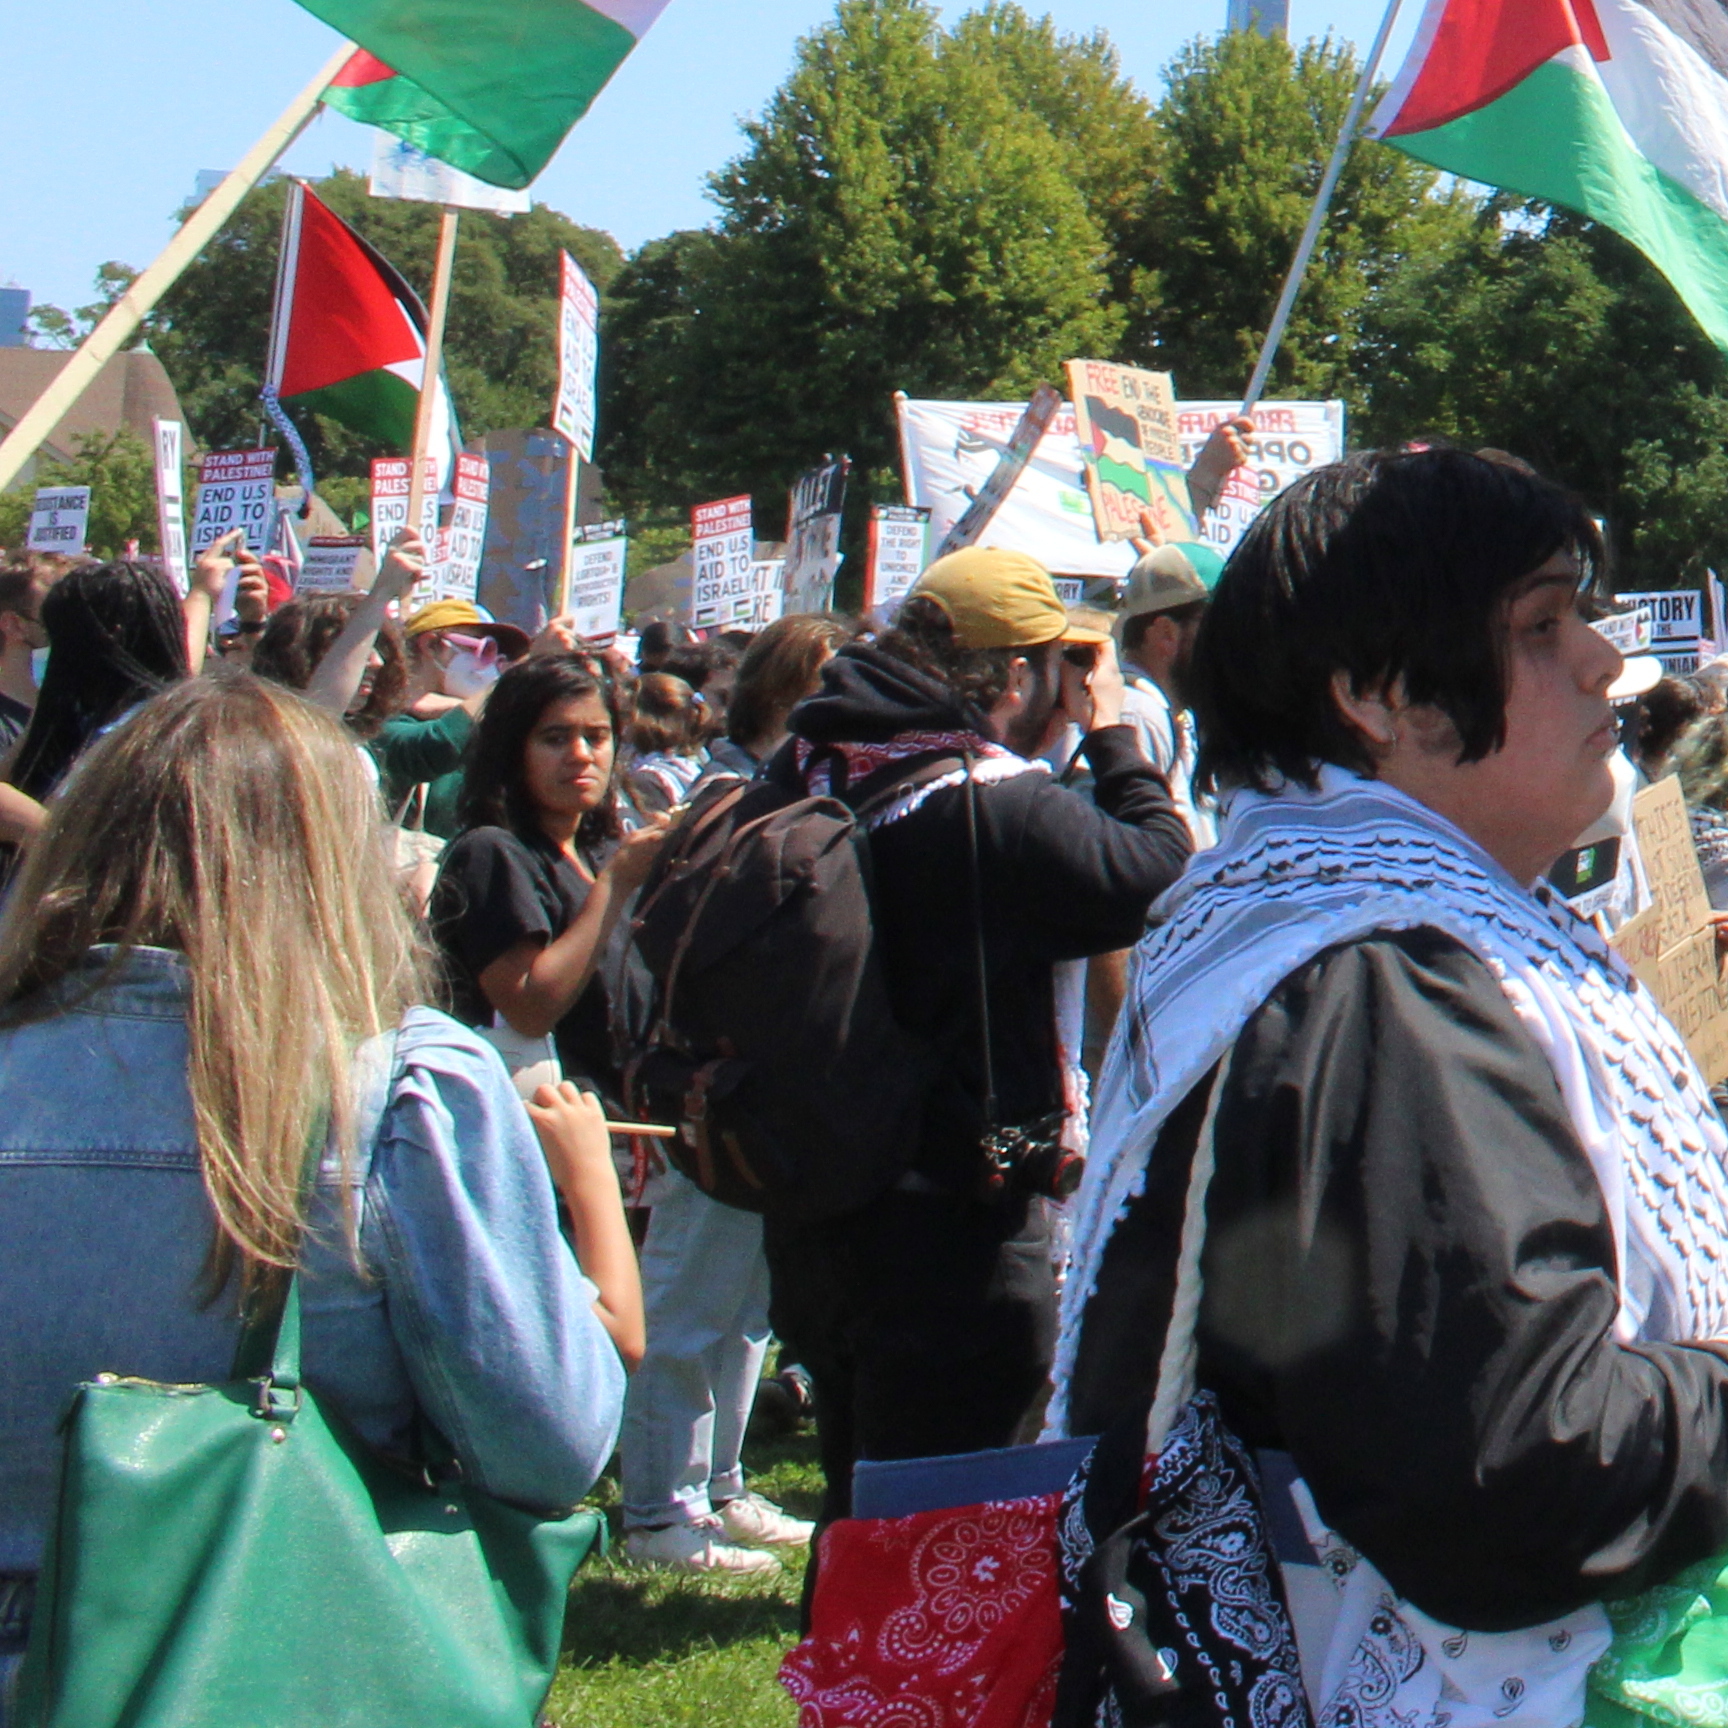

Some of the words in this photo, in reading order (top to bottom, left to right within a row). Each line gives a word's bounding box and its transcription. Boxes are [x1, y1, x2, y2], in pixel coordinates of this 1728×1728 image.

[1086, 363, 1120, 395] FREE
[1143, 381, 1161, 405] THE
[204, 454, 243, 467] STAND
[246, 450, 275, 464] WITH
[204, 463, 272, 481] PALESTINE!
[375, 462, 407, 476] STAND
[202, 487, 235, 503] END
[242, 484, 266, 500] U.S
[200, 505, 232, 522] AID
[241, 503, 265, 520] TO
[378, 504, 405, 521] END
[695, 504, 727, 521] STAND
[729, 499, 751, 513] WITH
[699, 541, 725, 560] END
[729, 535, 748, 552] U.S
[882, 537, 897, 547] THE
[896, 551, 906, 561] TO
[699, 561, 725, 582] AID
[730, 554, 749, 575] TO
[890, 576, 910, 585] AND
[697, 580, 749, 603] ISRAEL!
[1656, 623, 1672, 636] THE
